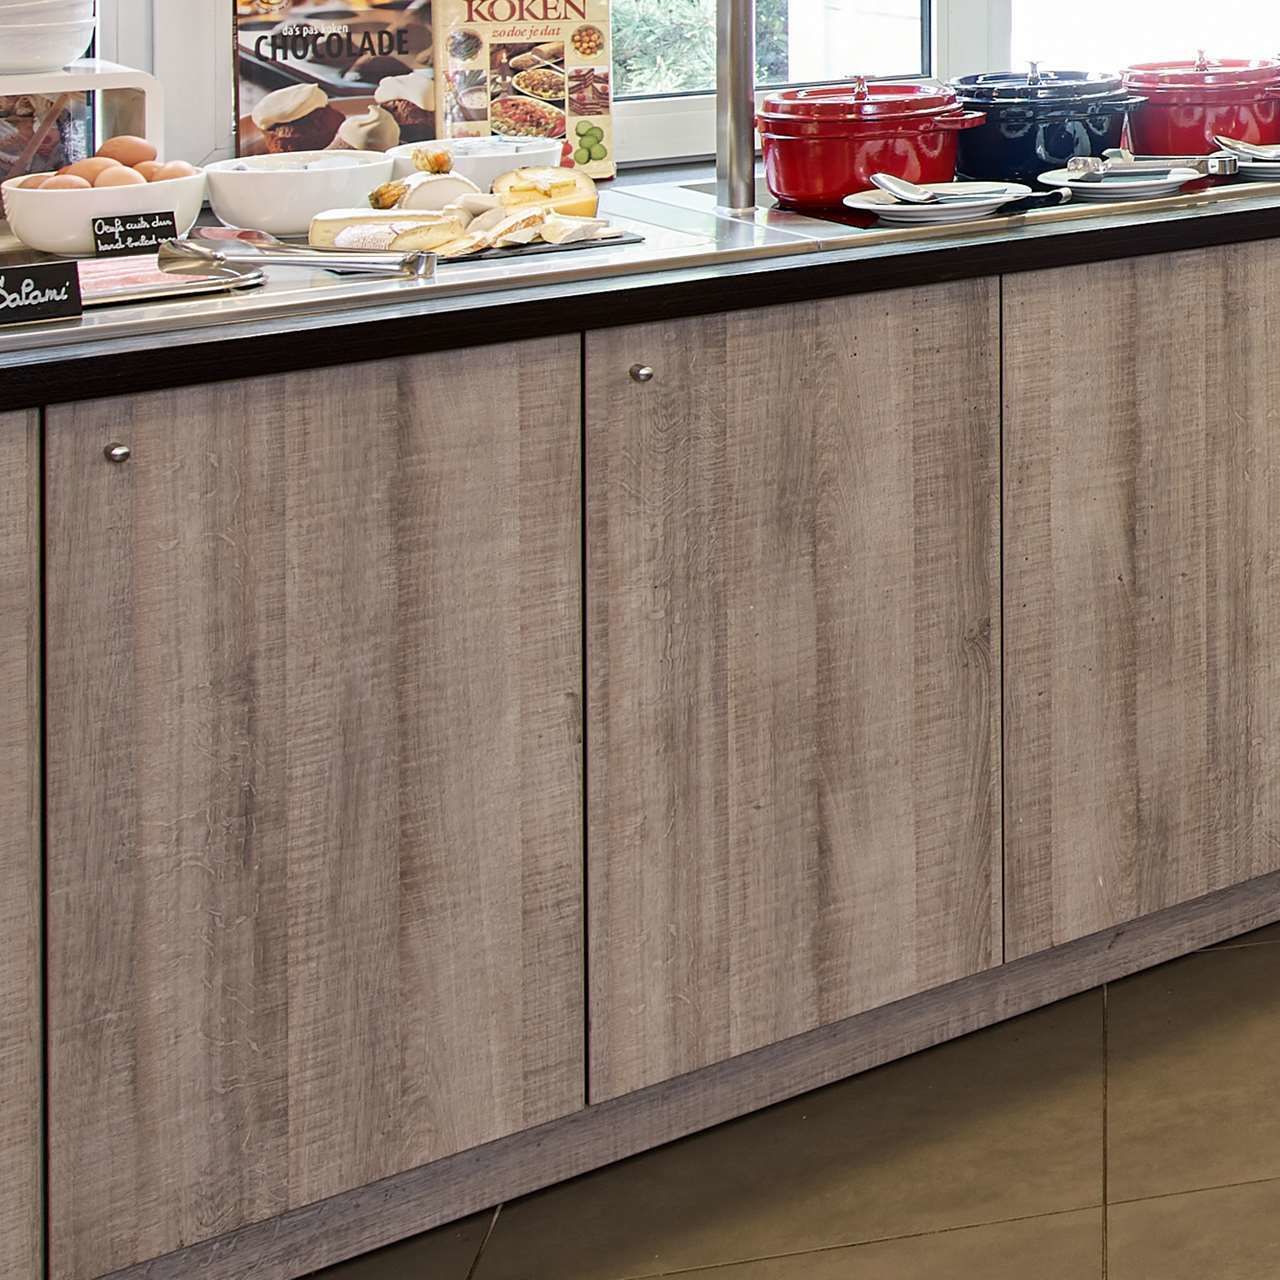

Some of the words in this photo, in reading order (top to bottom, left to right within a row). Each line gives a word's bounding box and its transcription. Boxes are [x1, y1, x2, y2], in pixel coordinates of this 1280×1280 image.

[302, 25, 318, 37] pas
[492, 28, 506, 38] zo
[507, 26, 527, 38] doe
[528, 25, 539, 40] je
[540, 25, 561, 37] dat
[255, 29, 409, 62] CHOCOLADE
